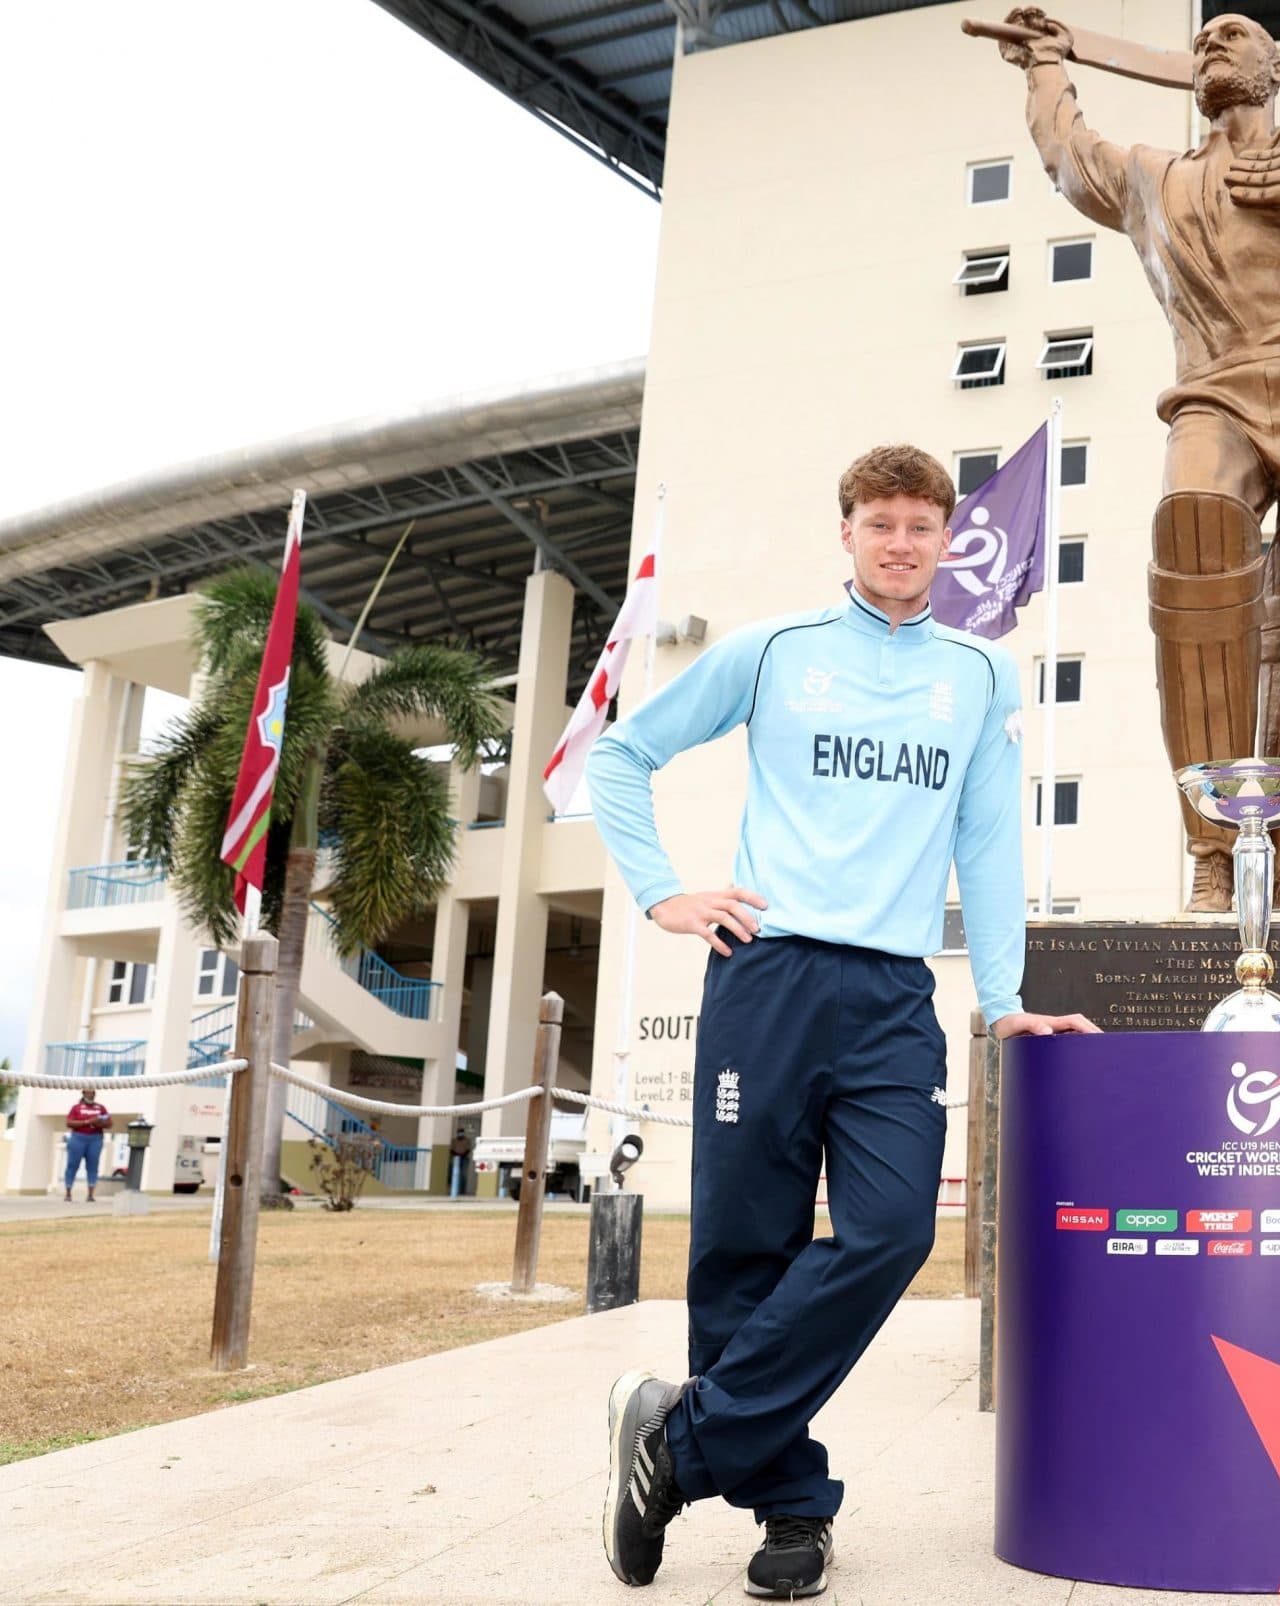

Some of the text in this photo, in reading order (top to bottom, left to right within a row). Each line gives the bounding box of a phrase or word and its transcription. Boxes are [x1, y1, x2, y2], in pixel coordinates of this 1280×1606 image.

[812, 734, 950, 791] ENGLAND
[1028, 940, 1044, 951] IR
[1050, 939, 1097, 951] ISAAC
[1103, 939, 1161, 951] VIVIAN
[1168, 940, 1243, 951] ALEXAND
[1140, 973, 1147, 984] 7
[1151, 973, 1197, 984] MARCH
[1173, 991, 1203, 1001] WEST
[639, 1016, 700, 1040] SOUT
[1222, 1141, 1238, 1150] ICC
[1240, 1141, 1258, 1151] U19
[1186, 1152, 1243, 1163] CRICKET
[1197, 1164, 1236, 1176] WEST
[1061, 1215, 1103, 1225] NISSAN
[1126, 1214, 1168, 1227] oppo
[1199, 1212, 1239, 1222] MRF
